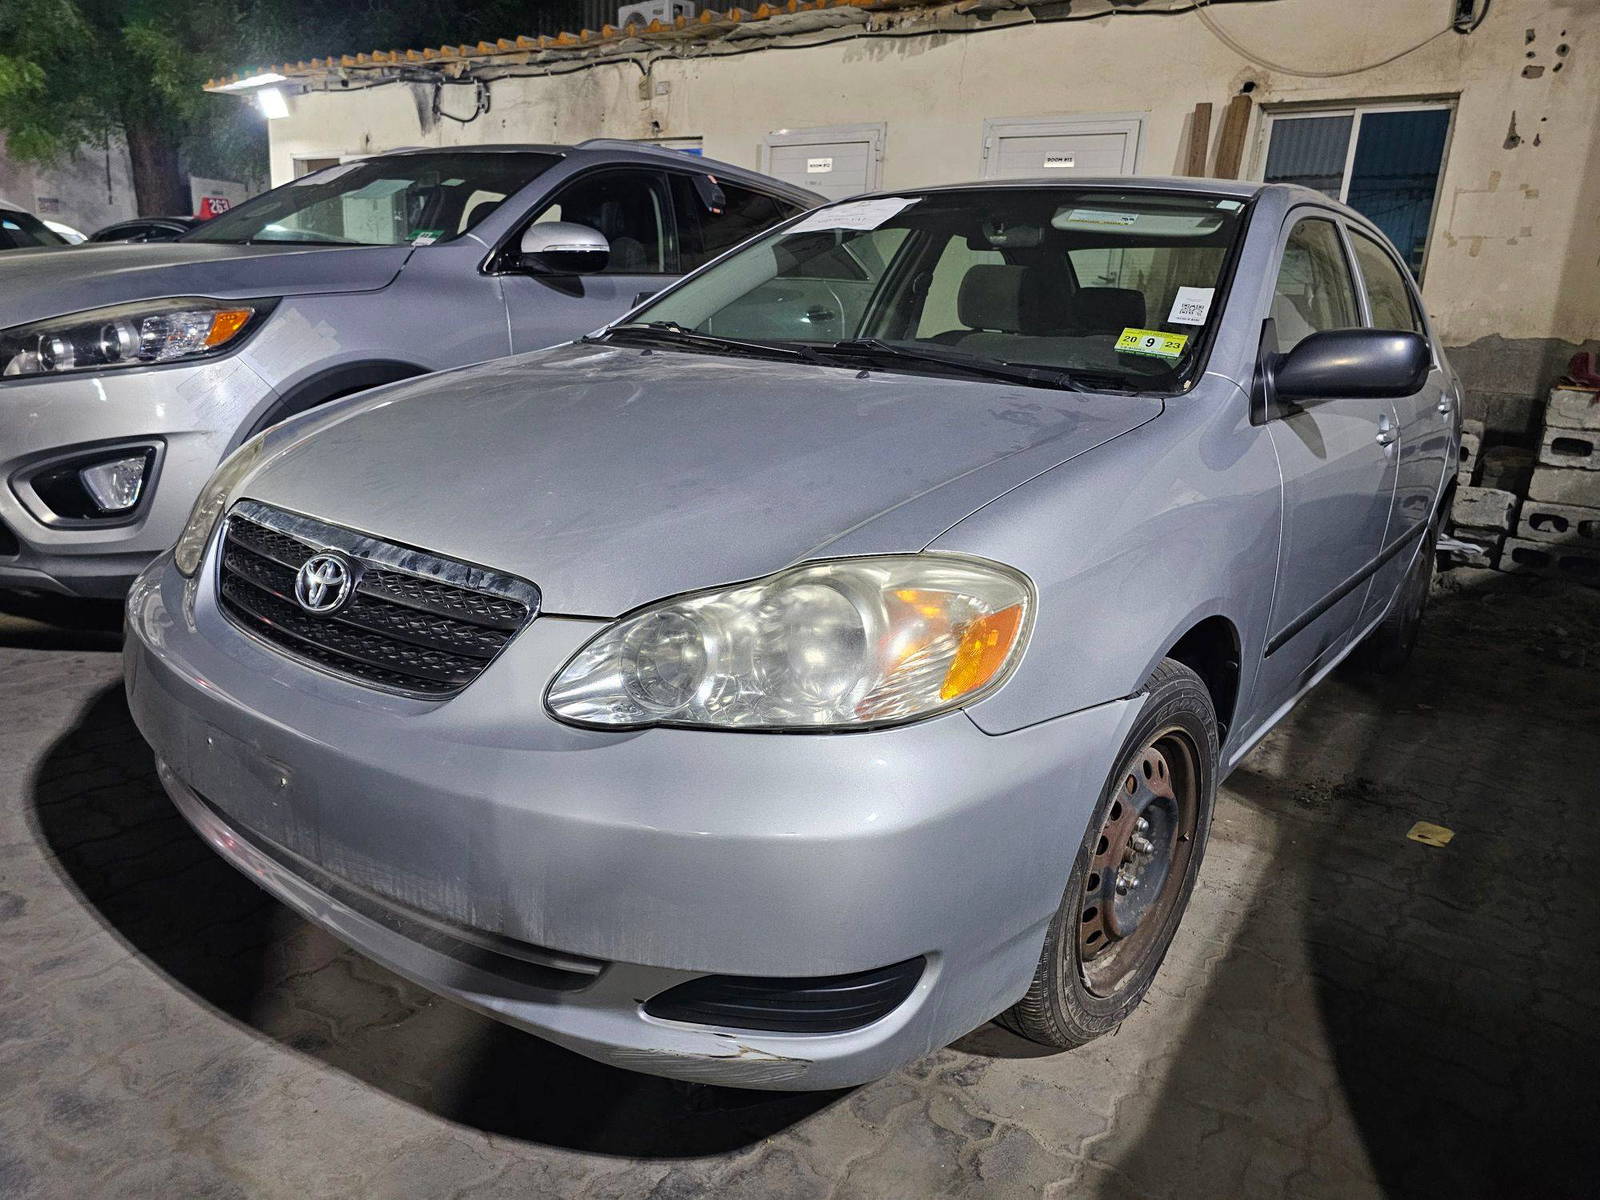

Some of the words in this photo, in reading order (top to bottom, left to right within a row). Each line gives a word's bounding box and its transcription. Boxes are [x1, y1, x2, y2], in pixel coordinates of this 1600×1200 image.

[1122, 335, 1138, 343] 20
[1145, 337, 1155, 348] 9
[1164, 341, 1181, 349] 23
